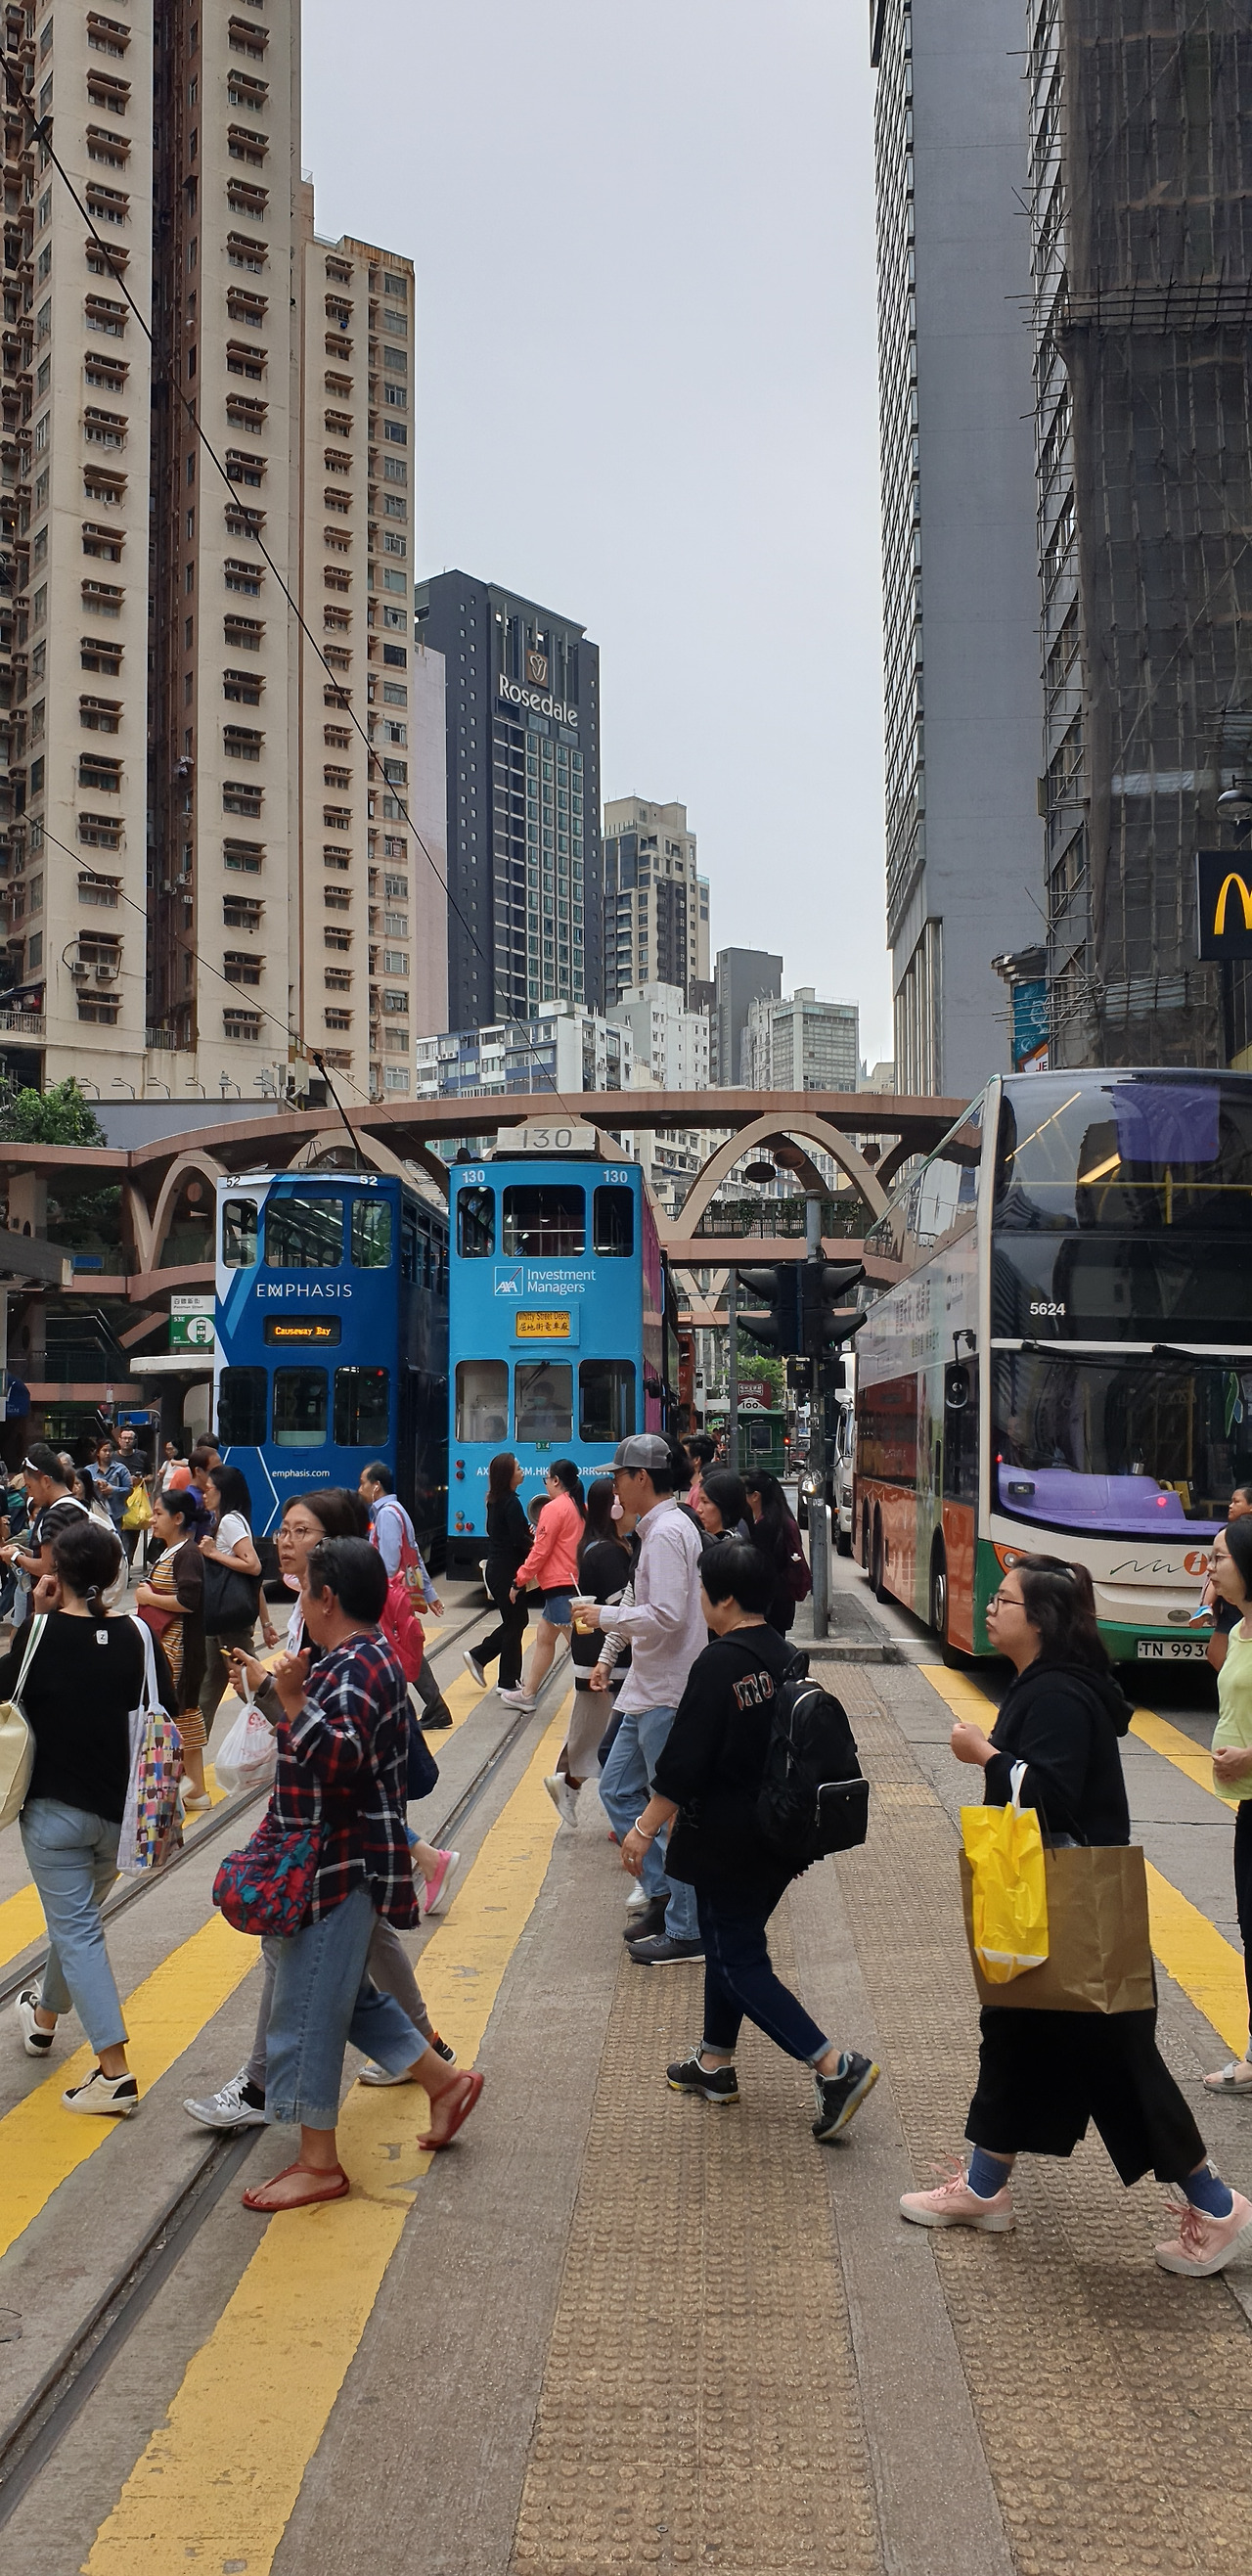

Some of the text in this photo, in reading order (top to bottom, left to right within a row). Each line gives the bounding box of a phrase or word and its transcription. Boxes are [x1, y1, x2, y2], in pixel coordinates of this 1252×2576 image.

[499, 673, 578, 727] Rosedale
[522, 1128, 572, 1149] 130
[226, 1176, 241, 1188] 52
[359, 1175, 379, 1187] 52
[462, 1170, 486, 1184] 130
[603, 1170, 628, 1184] 130
[527, 1269, 597, 1281] Investment
[256, 1284, 353, 1297] EMPHASIS
[496, 1281, 518, 1292] AXA
[527, 1281, 586, 1295] Managers
[1030, 1302, 1066, 1316] 5624
[275, 1327, 332, 1336] Causeway Bay
[272, 1469, 331, 1479] emphasis.com
[1141, 1642, 1209, 1657] TN 993
